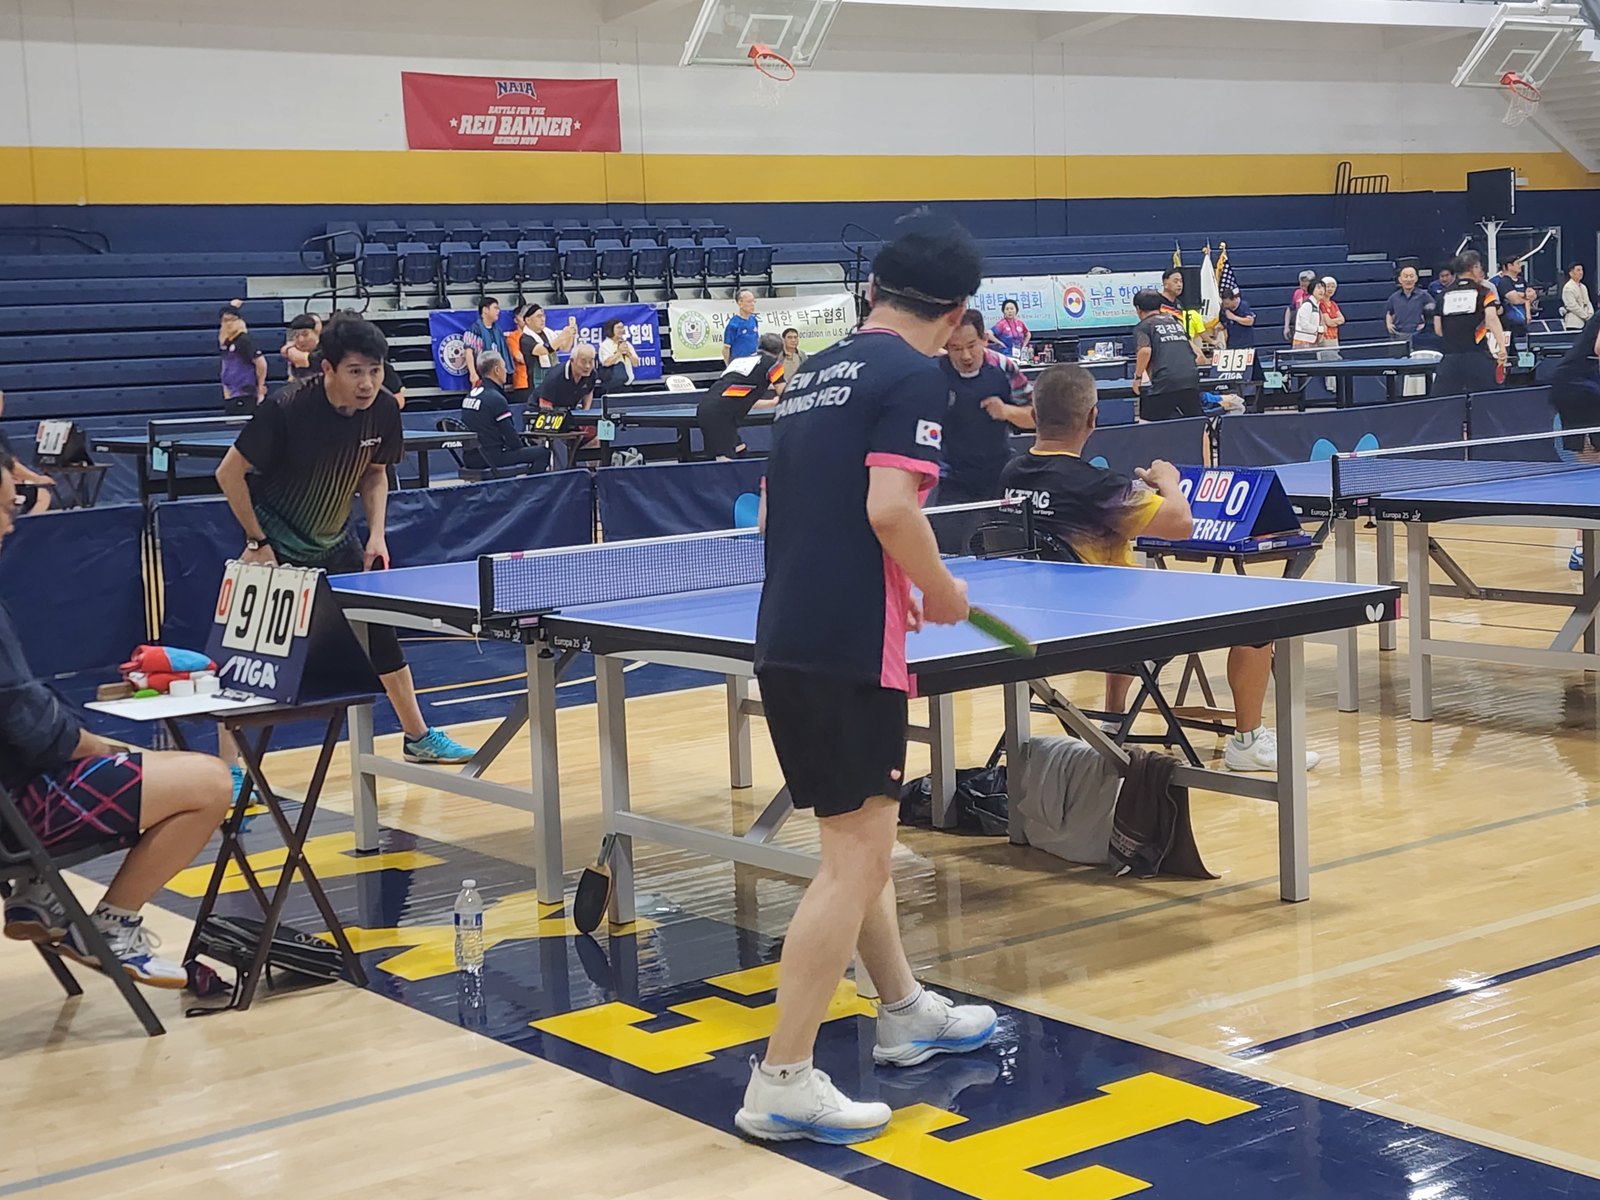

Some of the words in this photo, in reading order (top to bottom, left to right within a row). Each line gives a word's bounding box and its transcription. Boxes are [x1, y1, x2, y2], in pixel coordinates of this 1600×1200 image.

[495, 80, 537, 99] NAIA
[458, 115, 497, 135] RED
[498, 116, 573, 136] BANNER
[1090, 286, 1115, 306] 뉴욕
[766, 310, 792, 327] 대한
[797, 307, 847, 325] 탁구협회
[1221, 354, 1229, 369] 3
[1236, 354, 1244, 369] 3
[784, 372, 816, 393] EW
[1218, 372, 1244, 380] STIGA
[814, 386, 852, 408] HEO
[535, 414, 546, 429] 6
[1200, 477, 1213, 499] 0
[1215, 477, 1229, 500] 0
[1225, 480, 1250, 516] 0
[1310, 508, 1329, 517] Europa
[1382, 511, 1401, 519] Europa
[1192, 518, 1236, 542] TERFLY
[218, 578, 233, 617] 0
[235, 584, 258, 639] 9
[265, 588, 295, 646] 10
[300, 588, 310, 629] 1
[554, 635, 573, 648] Europa
[573, 638, 581, 649] 25
[219, 655, 278, 690] STIGA
